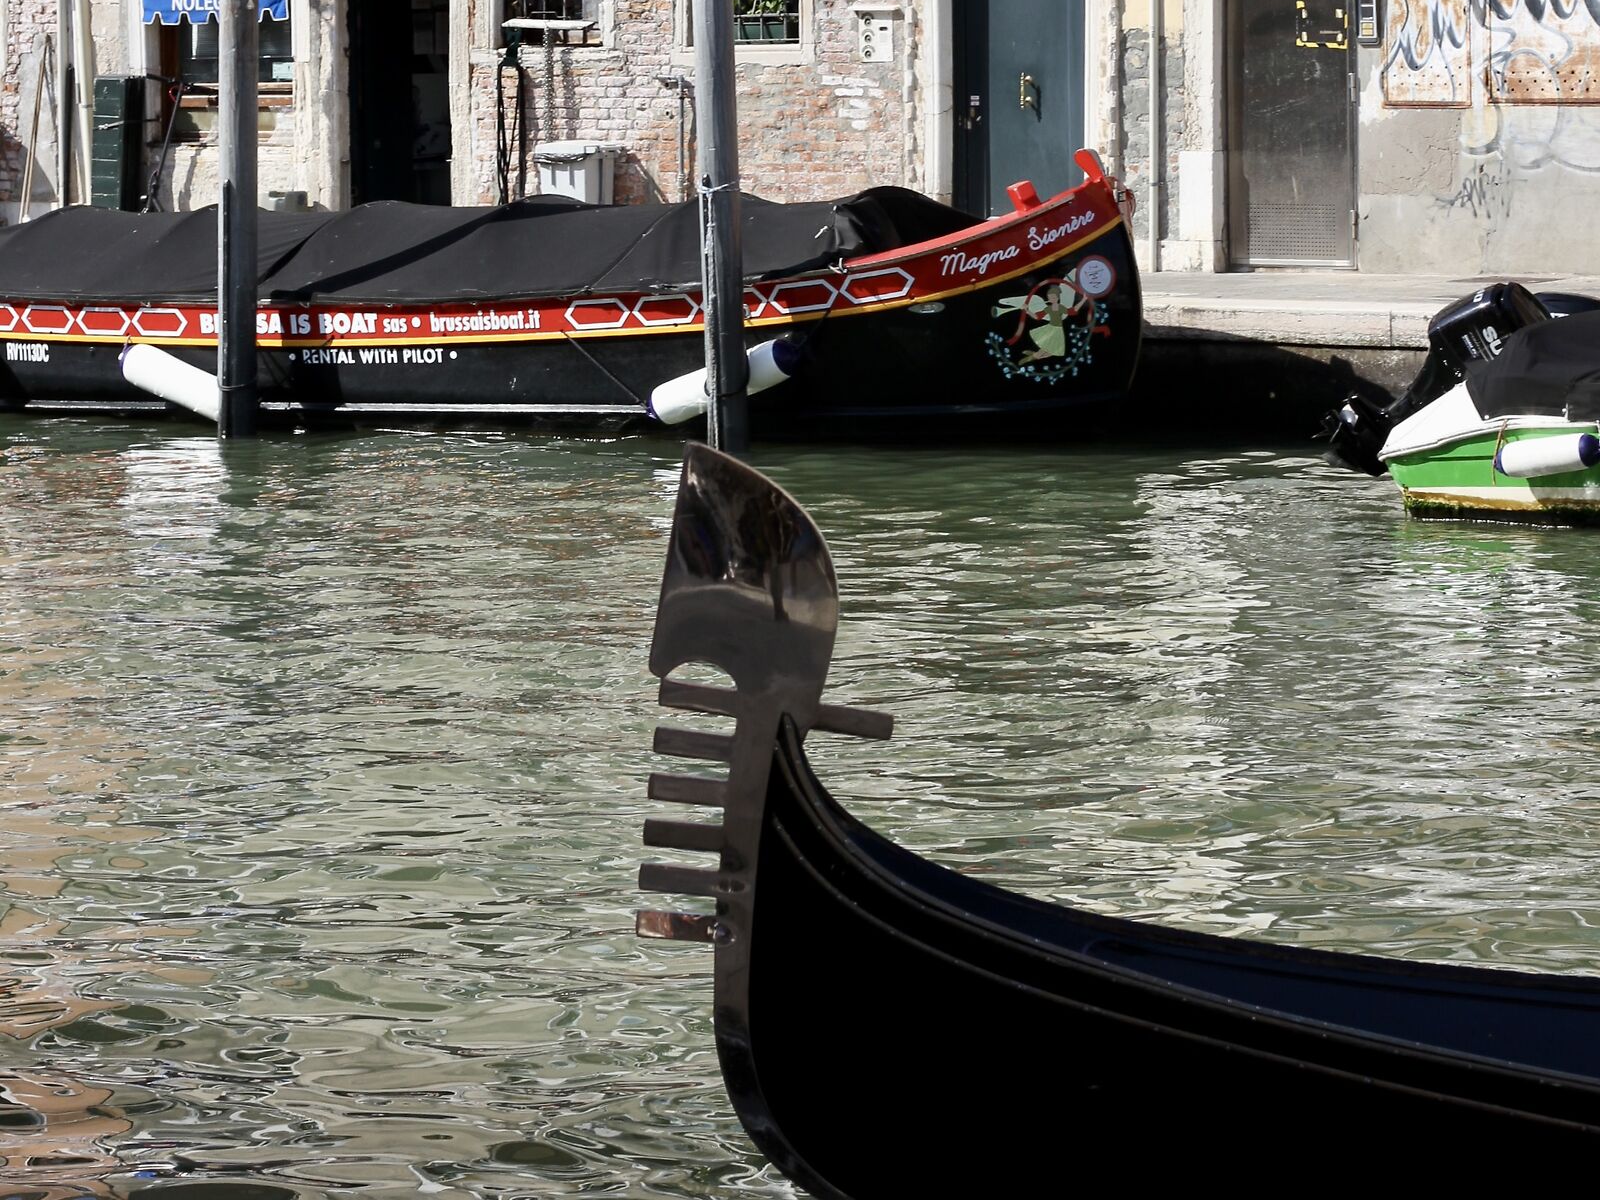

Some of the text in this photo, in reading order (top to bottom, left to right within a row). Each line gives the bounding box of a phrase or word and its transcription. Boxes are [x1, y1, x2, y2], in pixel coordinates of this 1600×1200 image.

[940, 245, 1020, 276] Magna
[199, 308, 541, 334] BSA IS BOAT sas brussaisboat.it
[302, 347, 444, 365] RENTAL WITH PILOT
